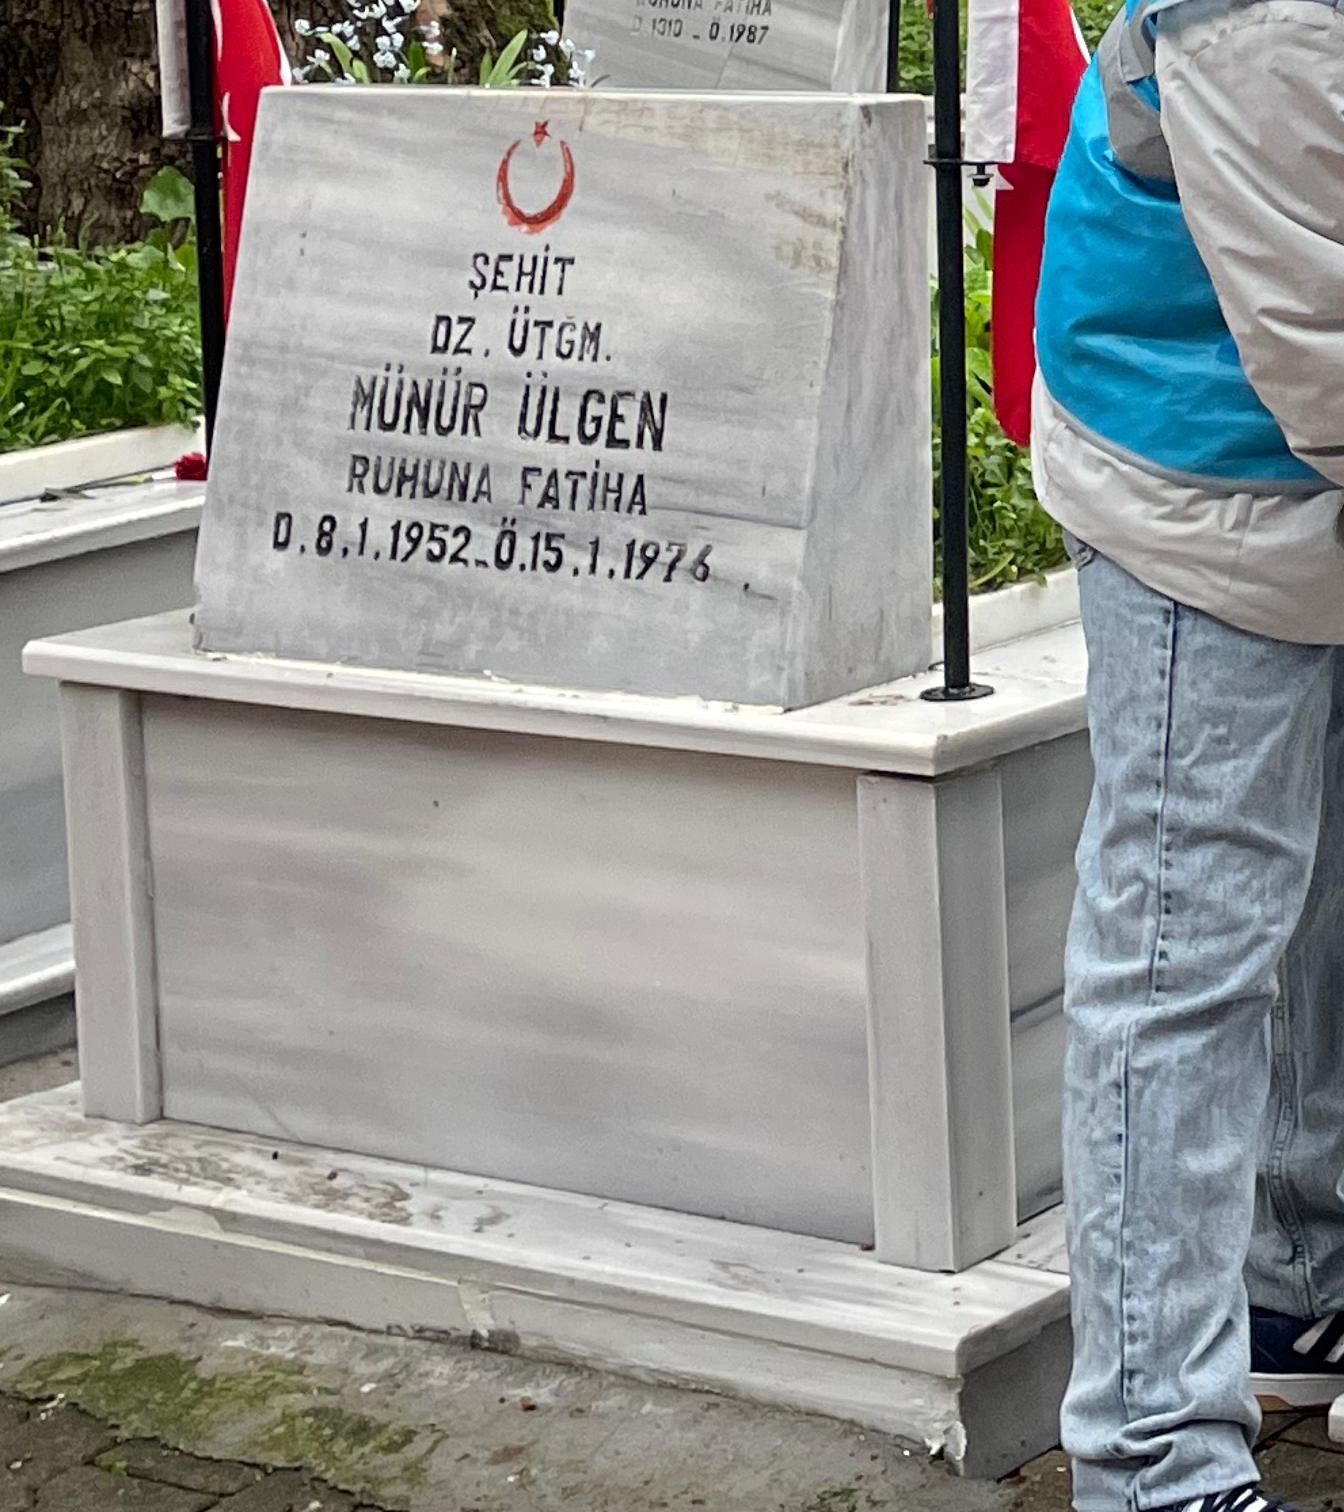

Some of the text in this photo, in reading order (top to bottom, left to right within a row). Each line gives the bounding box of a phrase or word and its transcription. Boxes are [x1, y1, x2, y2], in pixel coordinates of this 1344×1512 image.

[467, 243, 576, 301] ŞEHİT
[348, 366, 668, 452] MÜNÜR ÜLGEN
[346, 454, 648, 516] RUHUNA FATİHA
